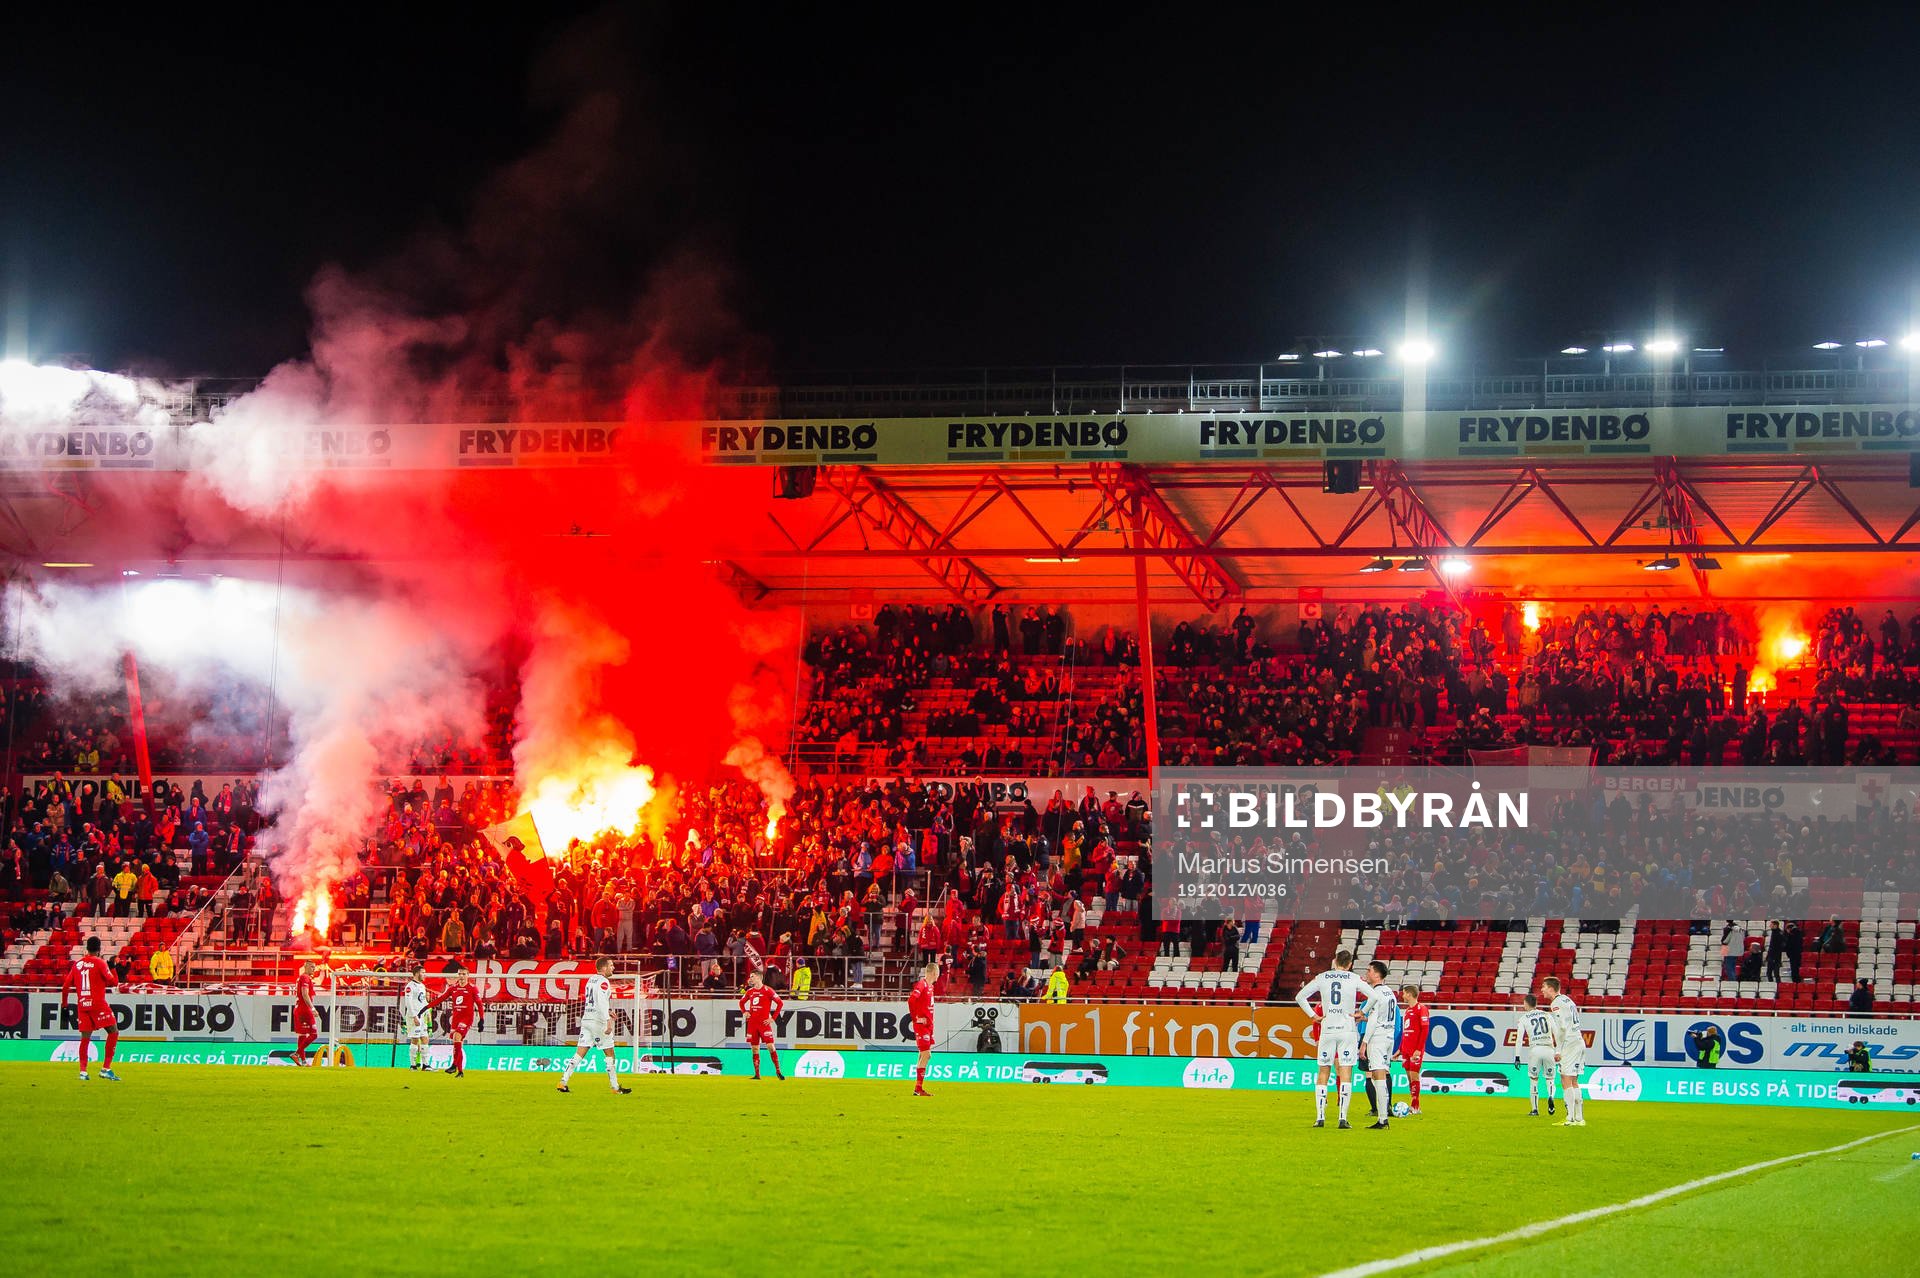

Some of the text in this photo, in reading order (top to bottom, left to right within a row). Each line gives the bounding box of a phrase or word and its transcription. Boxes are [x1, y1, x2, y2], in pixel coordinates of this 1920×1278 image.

[702, 422, 877, 451] FRYDENBØ
[948, 420, 1128, 448] FRYDENBØ
[1200, 416, 1385, 447] FRYDENBØ
[1459, 412, 1650, 442] FRYDENBØ
[1304, 603, 1317, 617] C
[1605, 776, 1687, 791] BERGEN
[1314, 935, 1320, 943] 7
[1309, 950, 1316, 958] 6
[1304, 966, 1310, 974] 5
[81, 969, 91, 991] 11
[1331, 981, 1342, 1005] 6
[489, 1003, 523, 1012] GLADE
[525, 1003, 567, 1013] GUTTER
[40, 1002, 235, 1034] FRDENBØ
[725, 1008, 917, 1043] FYDENBØ
[1530, 1016, 1549, 1036] 20
[1424, 1014, 1497, 1058] OS
[1791, 1023, 1807, 1033] alt
[1811, 1023, 1844, 1034] innen
[1848, 1024, 1898, 1036] bilskade
[487, 1056, 524, 1071] LEIE
[577, 1054, 598, 1073] PÅ
[802, 1060, 839, 1076] tide
[866, 1063, 904, 1078] LEIE
[958, 1061, 980, 1079] PÅ
[985, 1065, 1023, 1081] TIDE
[1189, 1067, 1229, 1083] tide
[1257, 1071, 1295, 1085] LEIE
[1599, 1077, 1636, 1094] tide
[1666, 1079, 1837, 1099] LEIE BUSS PÅ TIDE
